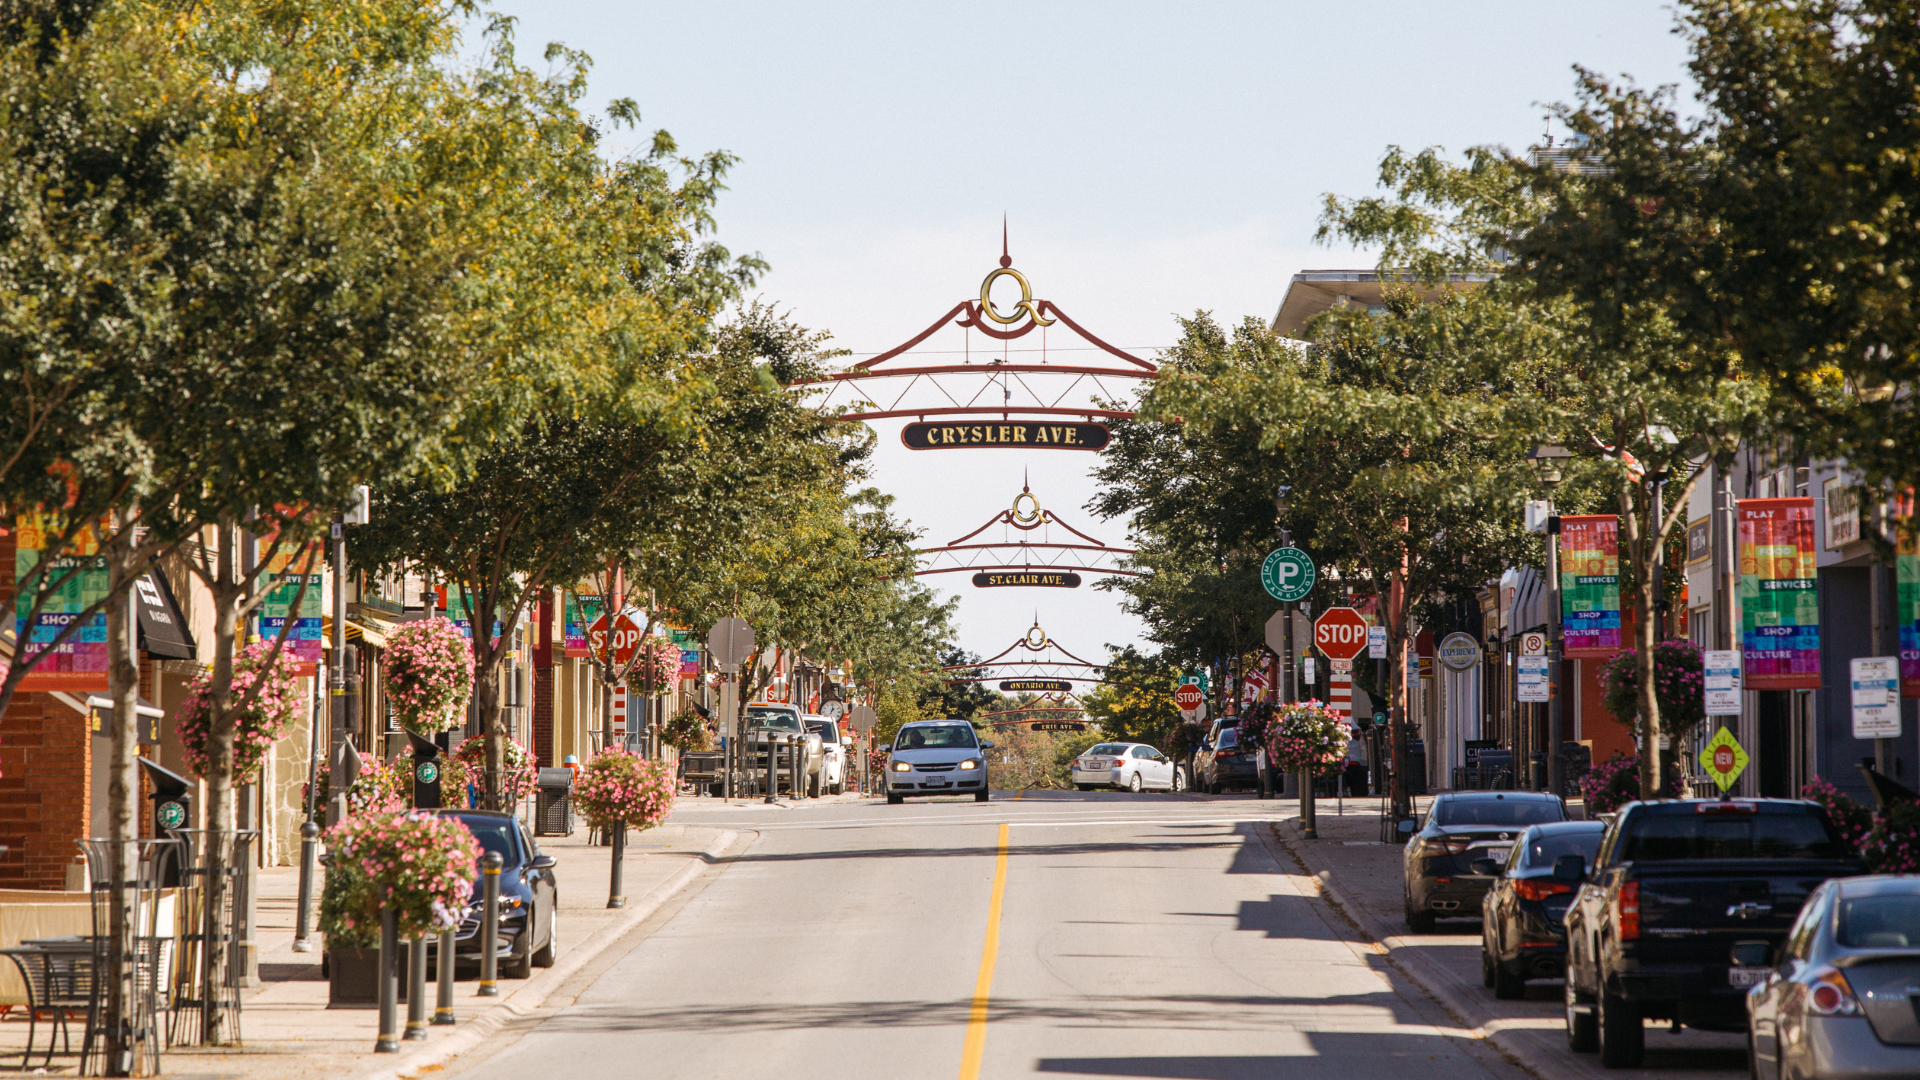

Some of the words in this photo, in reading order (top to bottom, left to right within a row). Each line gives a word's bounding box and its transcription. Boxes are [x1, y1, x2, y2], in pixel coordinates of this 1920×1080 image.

[927, 426, 1027, 444] CRYSLER
[1035, 426, 1084, 445] AVE.
[1747, 510, 1775, 519] PLAY
[1759, 547, 1792, 556] FOOD
[1264, 550, 1312, 573] MUNICIPAL
[1041, 575, 1065, 585] AVE.
[1579, 576, 1616, 584] SERVICES
[1764, 580, 1813, 589] SERVICES
[1265, 579, 1311, 598] PARKING
[271, 619, 299, 627] SHP
[1318, 624, 1365, 643] STOP
[1564, 629, 1600, 637] CULTURE
[1764, 627, 1793, 636] SHOP
[1443, 647, 1477, 657] EXPERIENCE
[1744, 650, 1792, 659] CULTURE
[1010, 682, 1044, 690] ONTARIO
[1177, 692, 1201, 703] STOP
[1715, 752, 1733, 765] NEW
